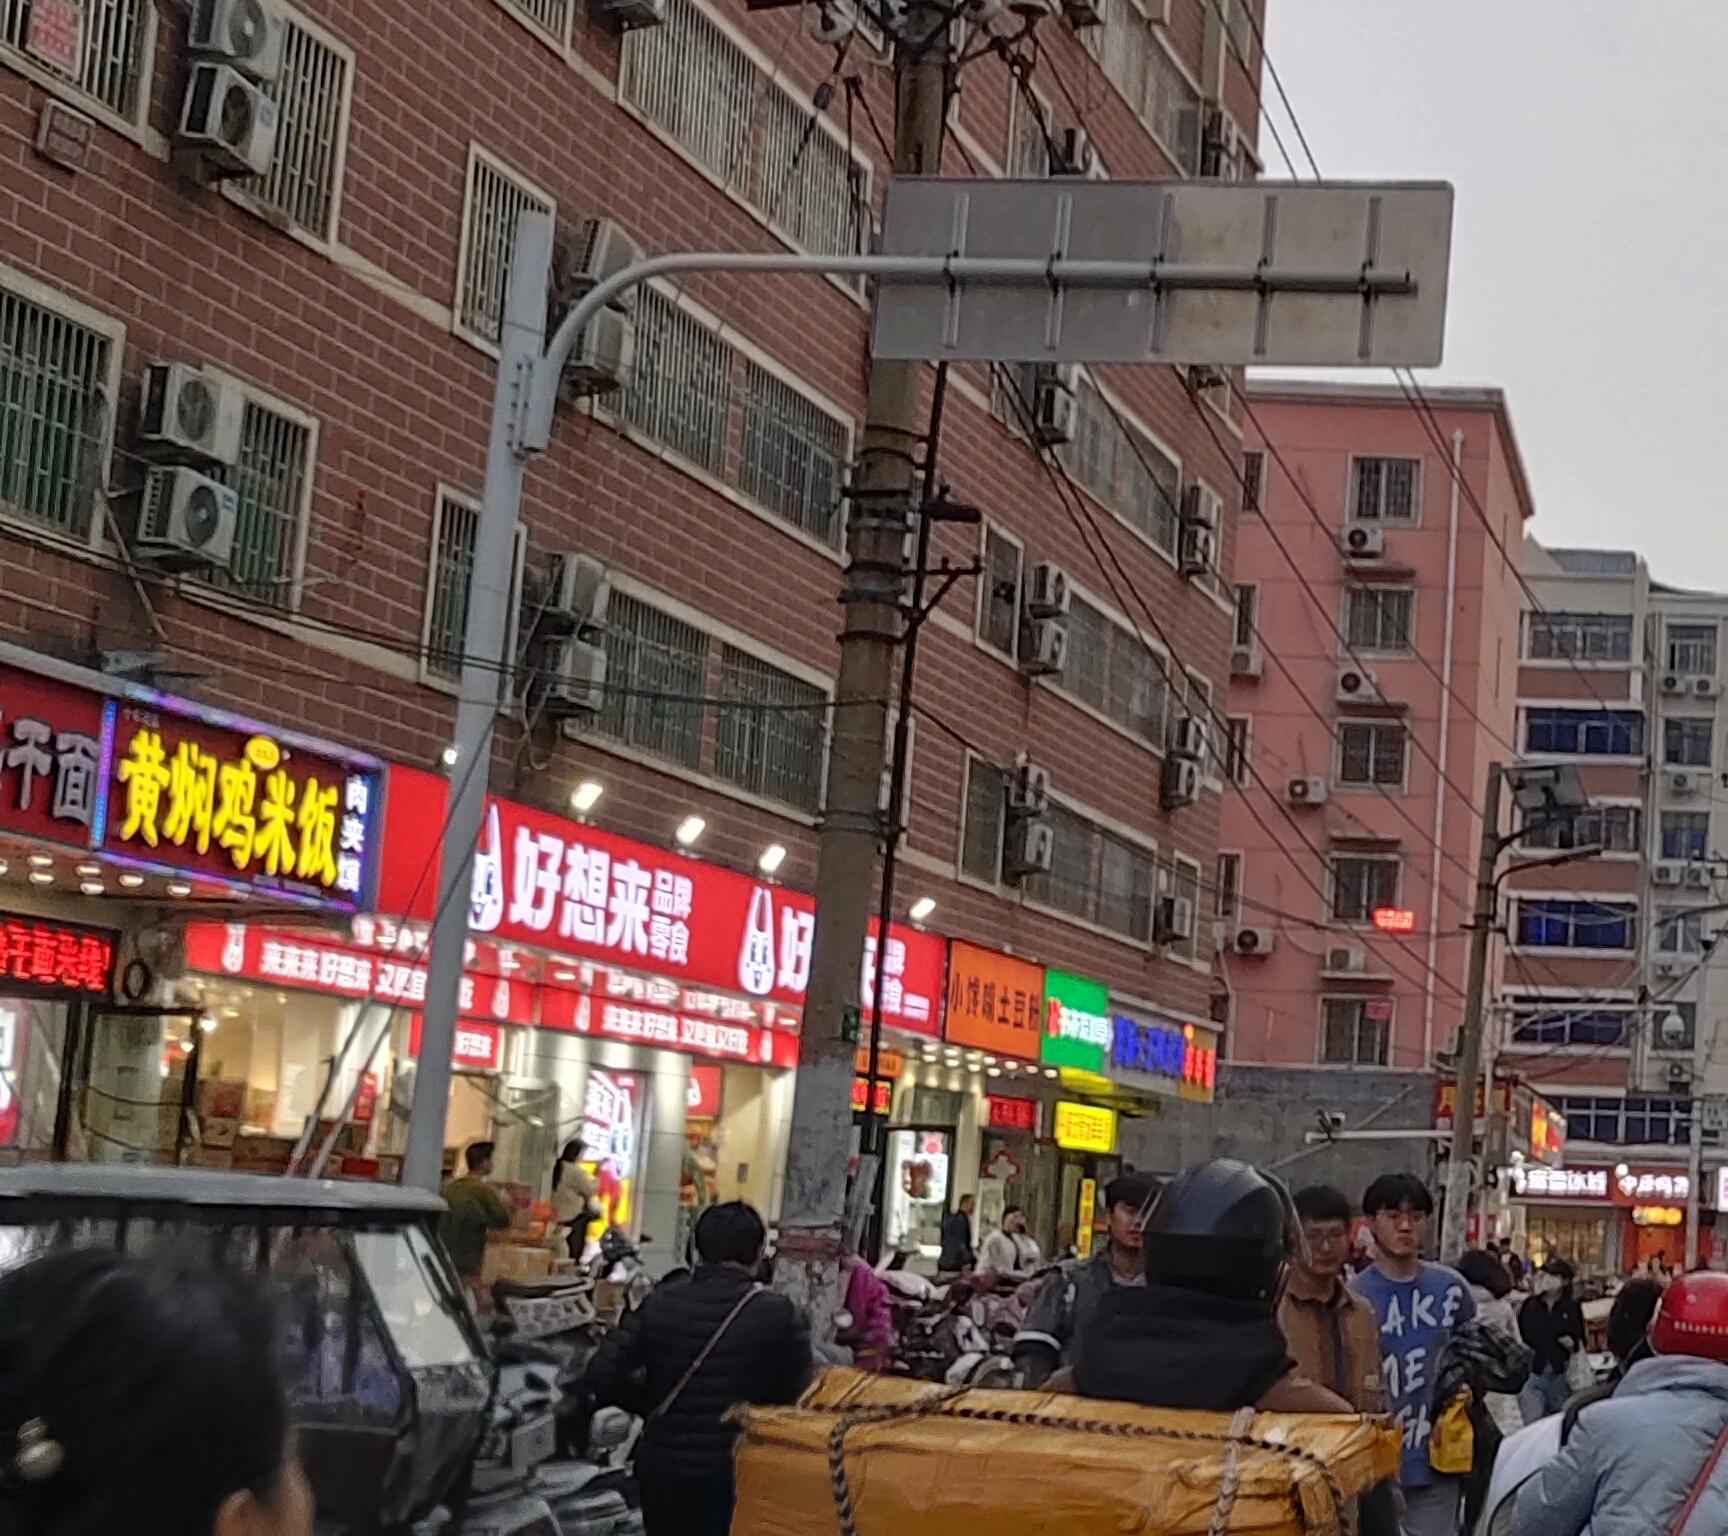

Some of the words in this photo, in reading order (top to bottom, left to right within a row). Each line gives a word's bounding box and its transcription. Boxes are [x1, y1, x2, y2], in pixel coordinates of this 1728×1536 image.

[0, 712, 99, 825] 干面
[117, 728, 340, 886] 黄焖鸡米饭
[508, 825, 651, 955] 好想来
[653, 868, 693, 919] 品牌
[648, 914, 691, 966] 零食
[1526, 1169, 1607, 1196] 蜜雪冰城
